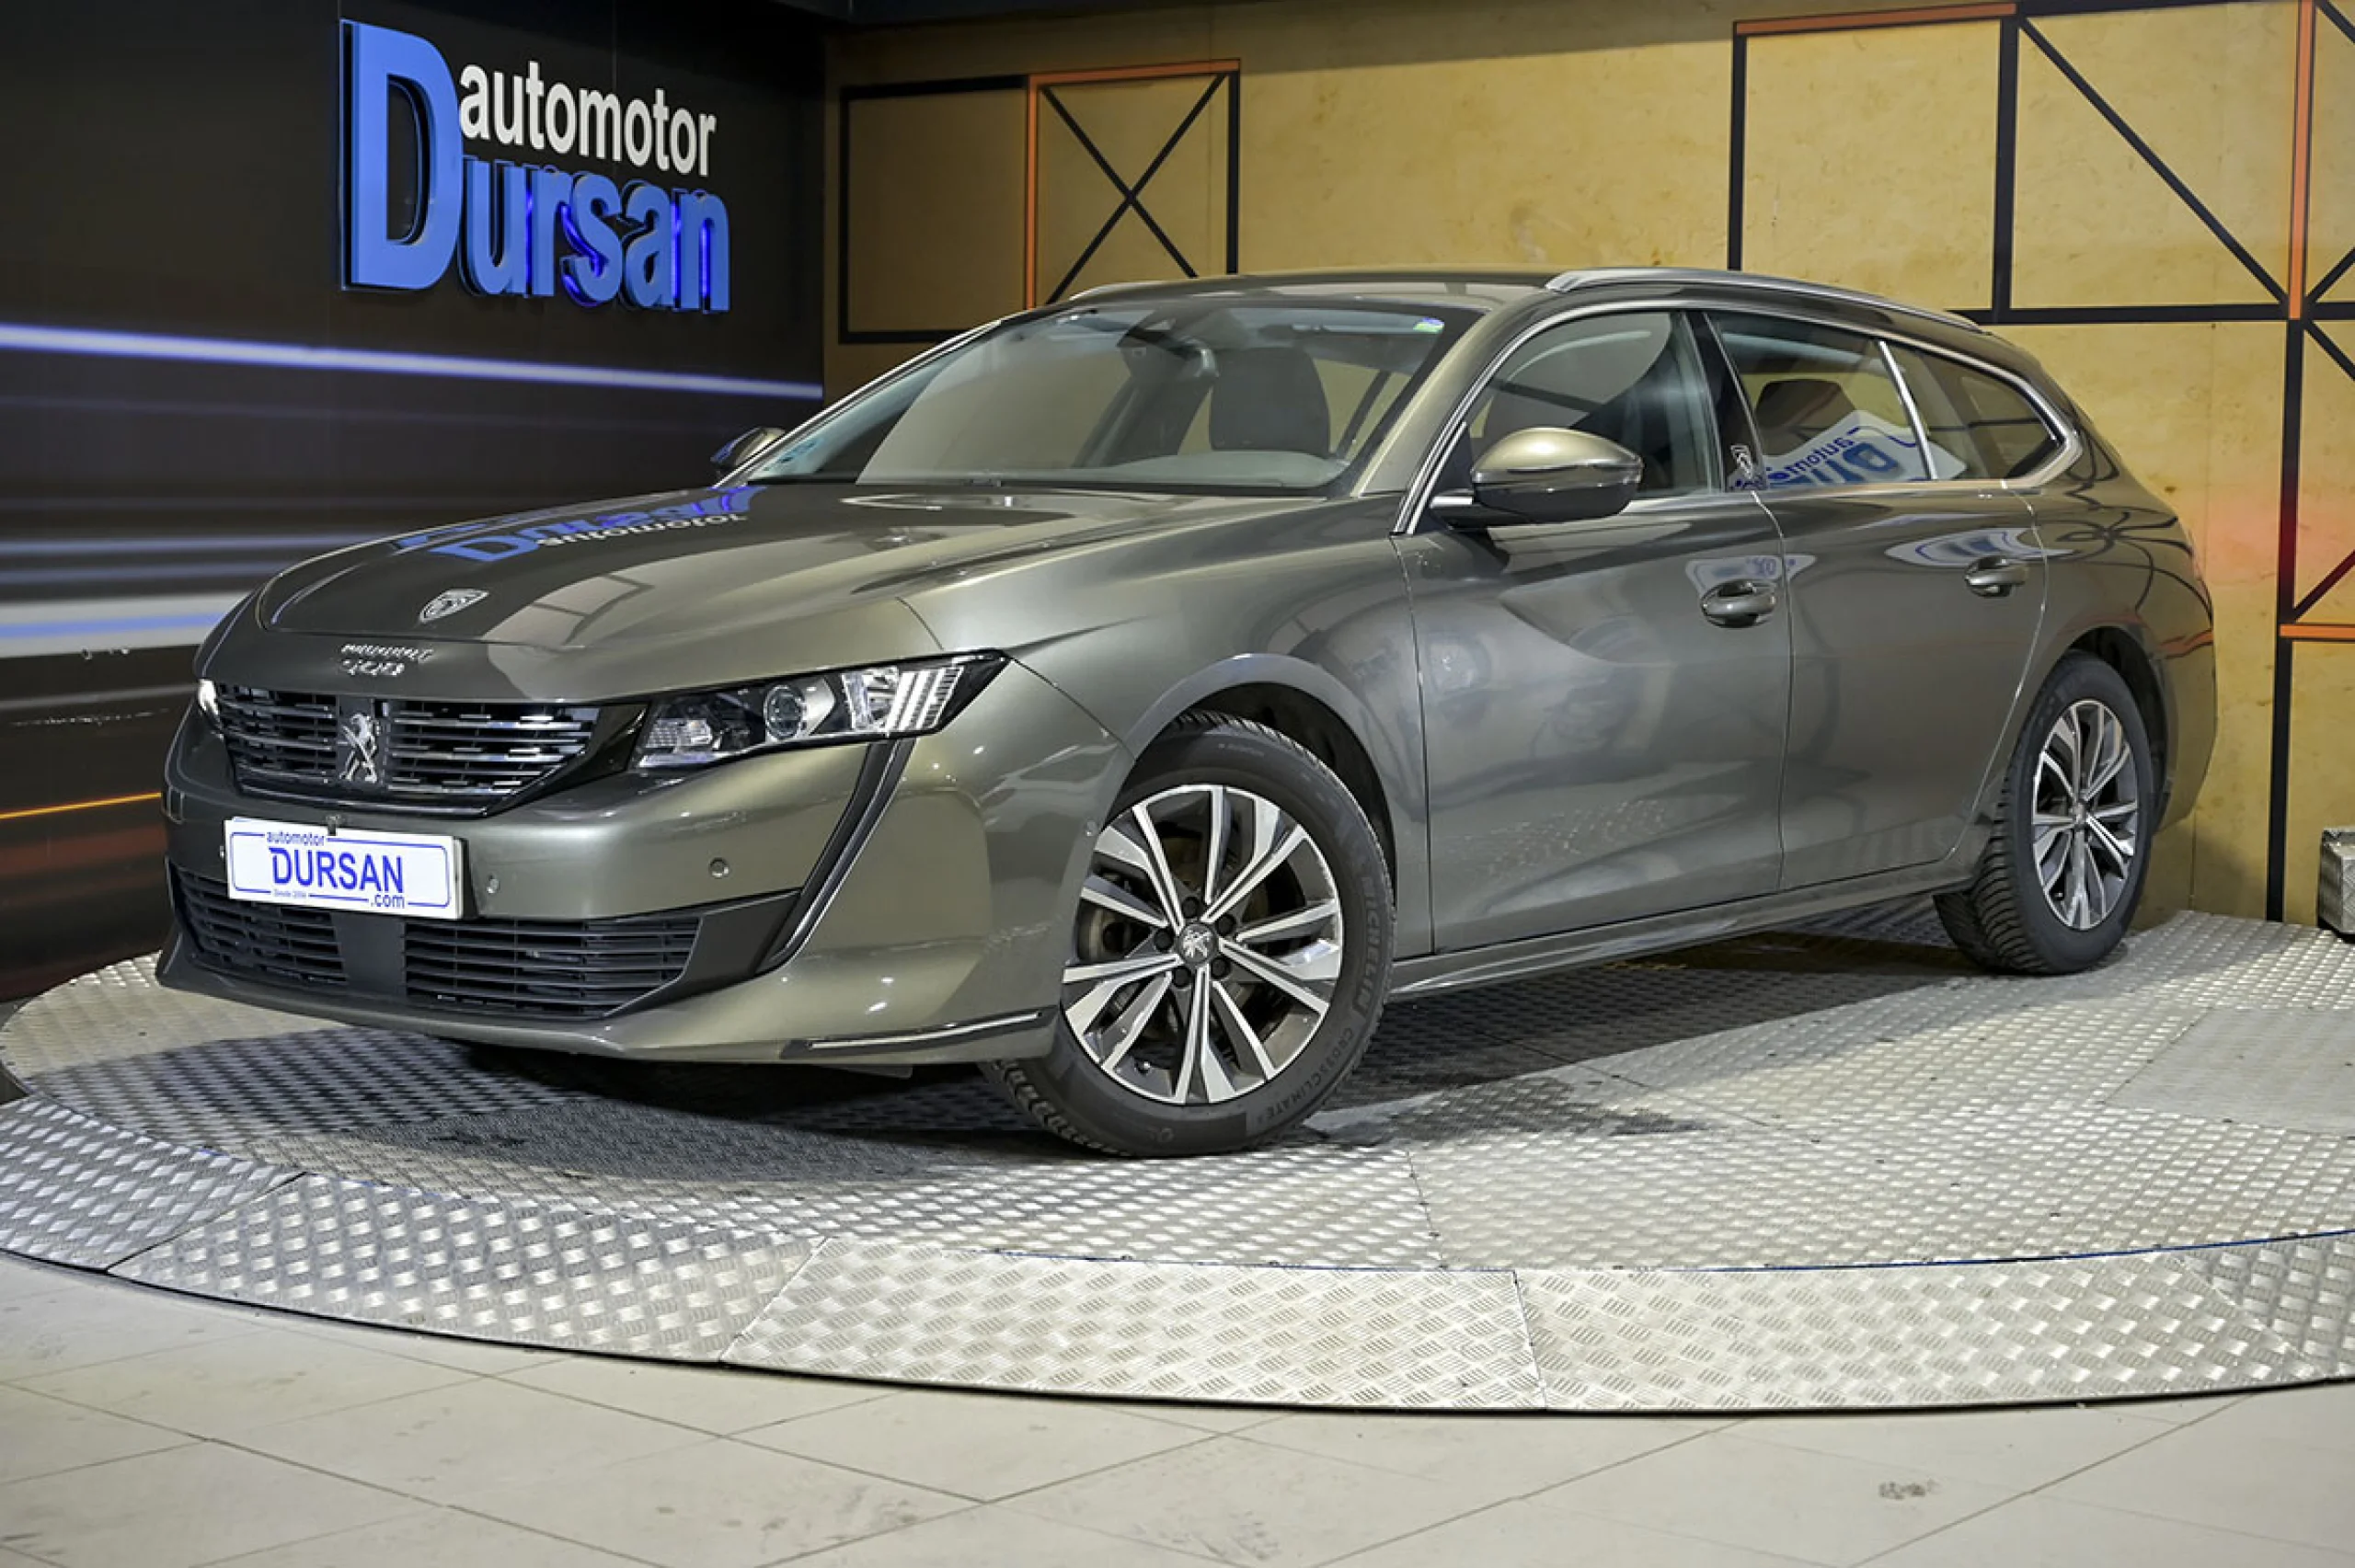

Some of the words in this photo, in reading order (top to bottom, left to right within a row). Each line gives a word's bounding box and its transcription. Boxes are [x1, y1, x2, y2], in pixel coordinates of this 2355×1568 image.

[459, 61, 718, 177] automotor
[339, 18, 731, 314] Dursan
[266, 831, 325, 847] automotor
[268, 847, 405, 894] DURSAN
[370, 893, 406, 909] .com
